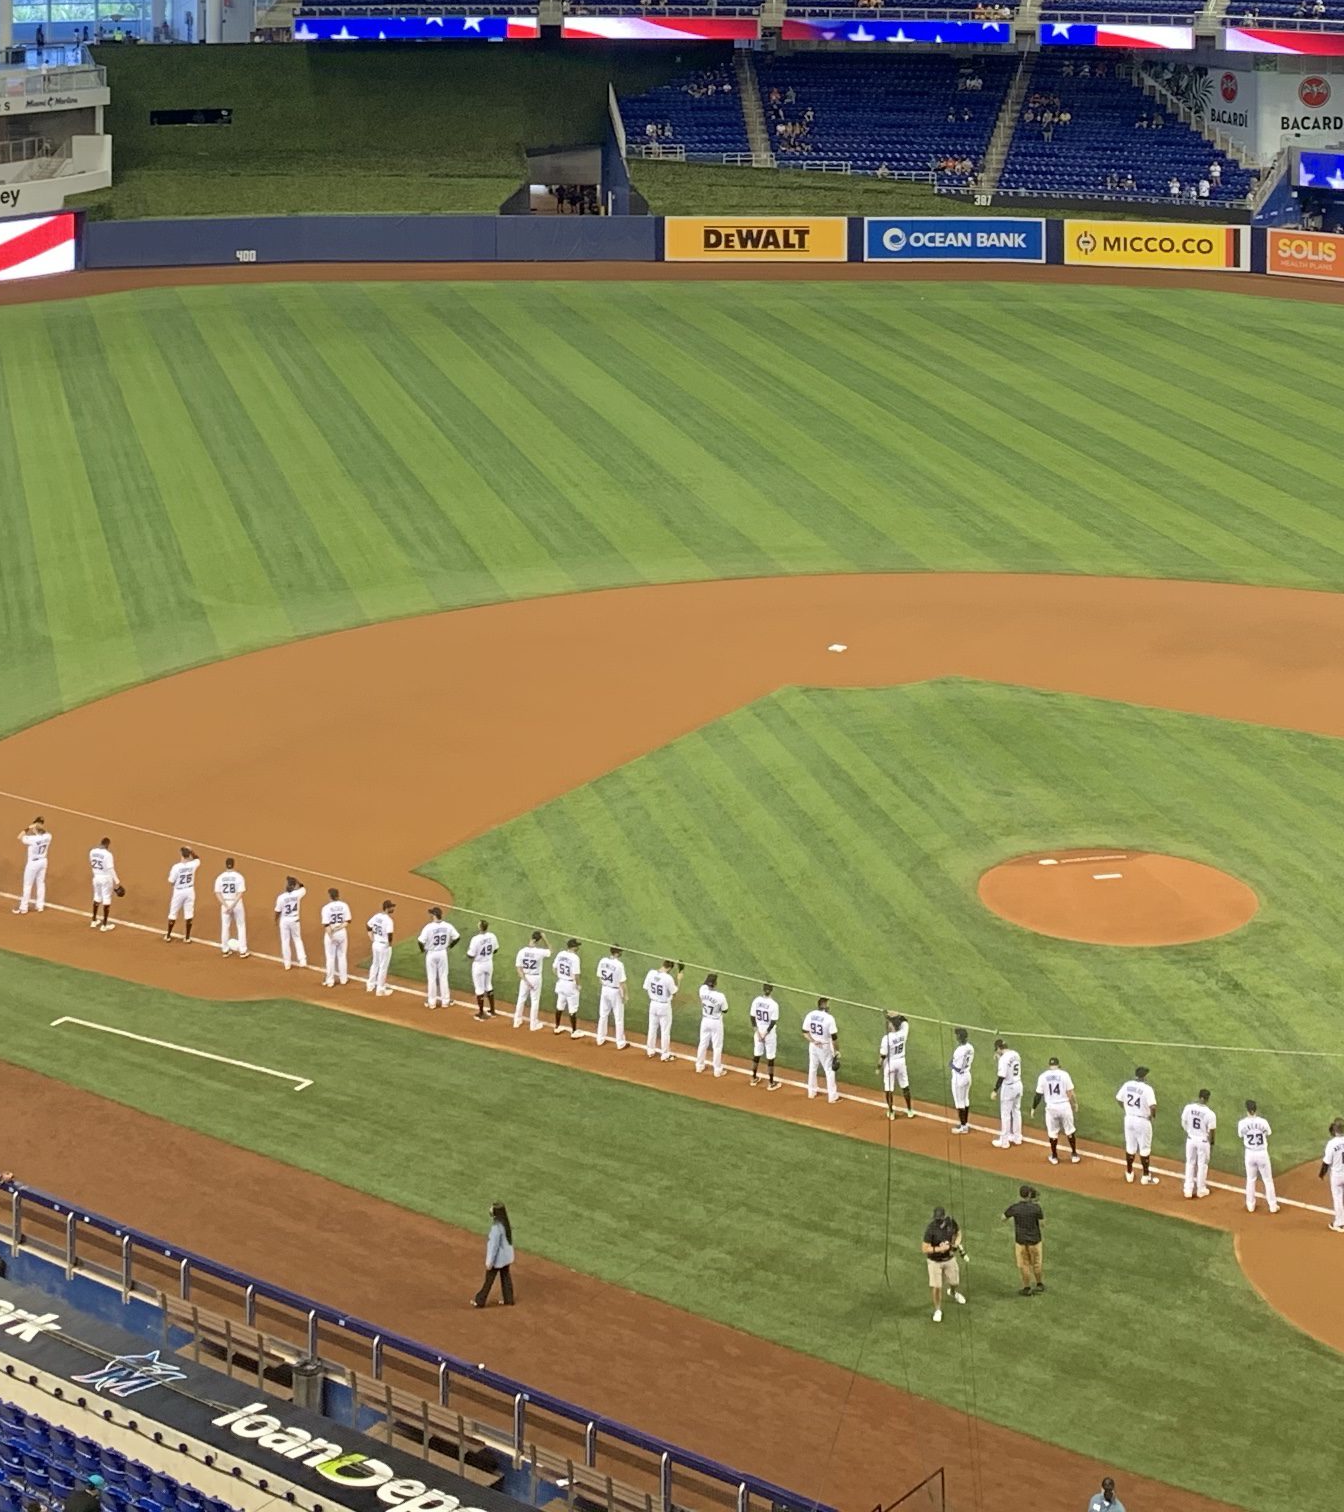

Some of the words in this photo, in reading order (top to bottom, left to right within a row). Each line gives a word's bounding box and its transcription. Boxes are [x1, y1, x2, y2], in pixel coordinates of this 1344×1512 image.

[909, 232, 972, 248] OCEAN
[977, 233, 1027, 248] BANK
[1103, 236, 1213, 255] MICCO.CO
[1278, 239, 1336, 262] SOLIS
[1048, 1083, 1060, 1096] 14
[1127, 1094, 1141, 1108] 24
[1246, 1133, 1264, 1146] 23
